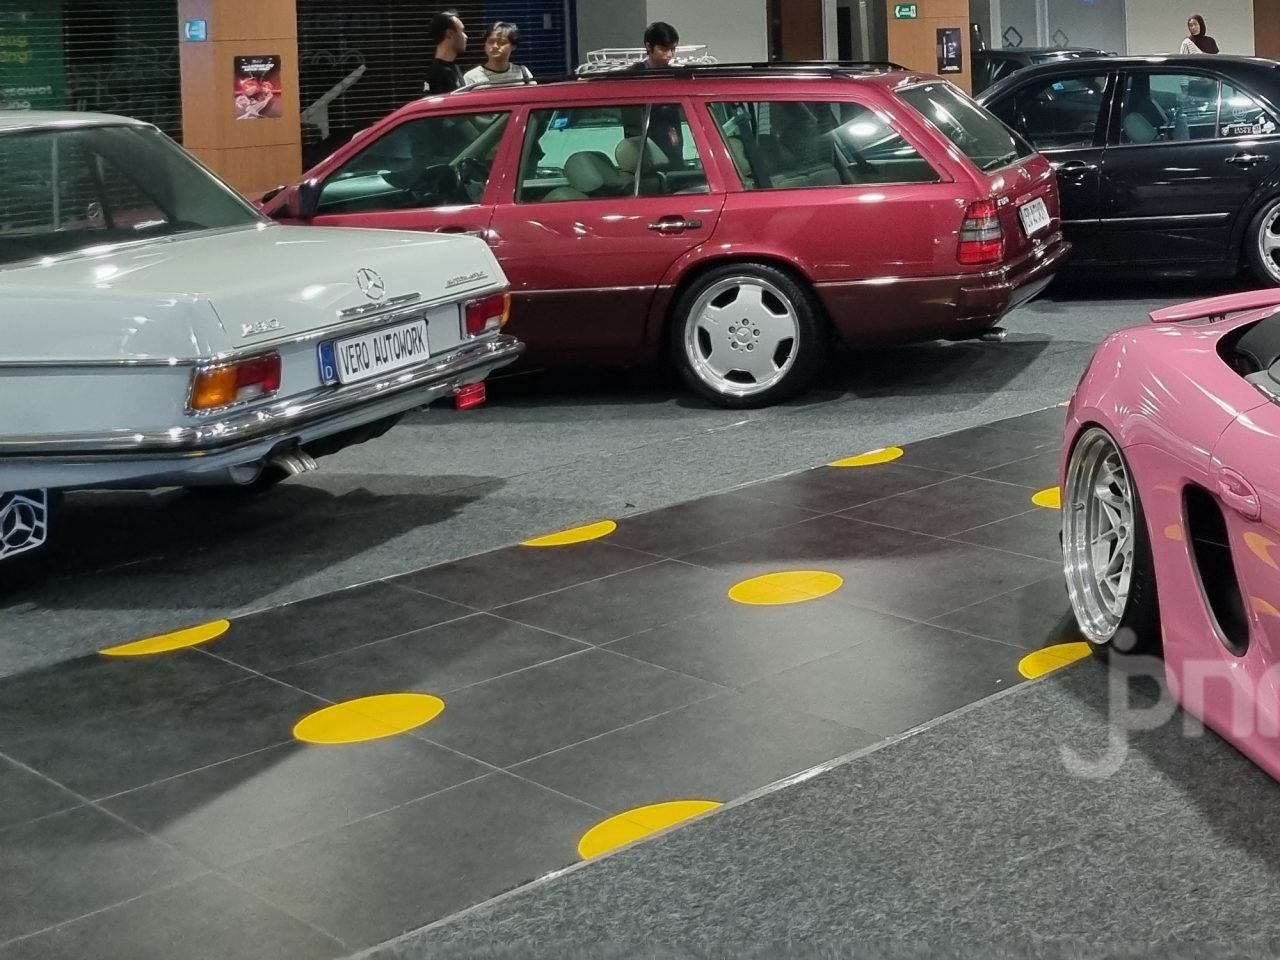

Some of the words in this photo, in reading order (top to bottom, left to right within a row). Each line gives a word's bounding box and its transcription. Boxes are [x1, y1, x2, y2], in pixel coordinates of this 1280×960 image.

[340, 341, 371, 376] VERO
[374, 324, 427, 367] AUTOWORK
[325, 365, 333, 380] D
